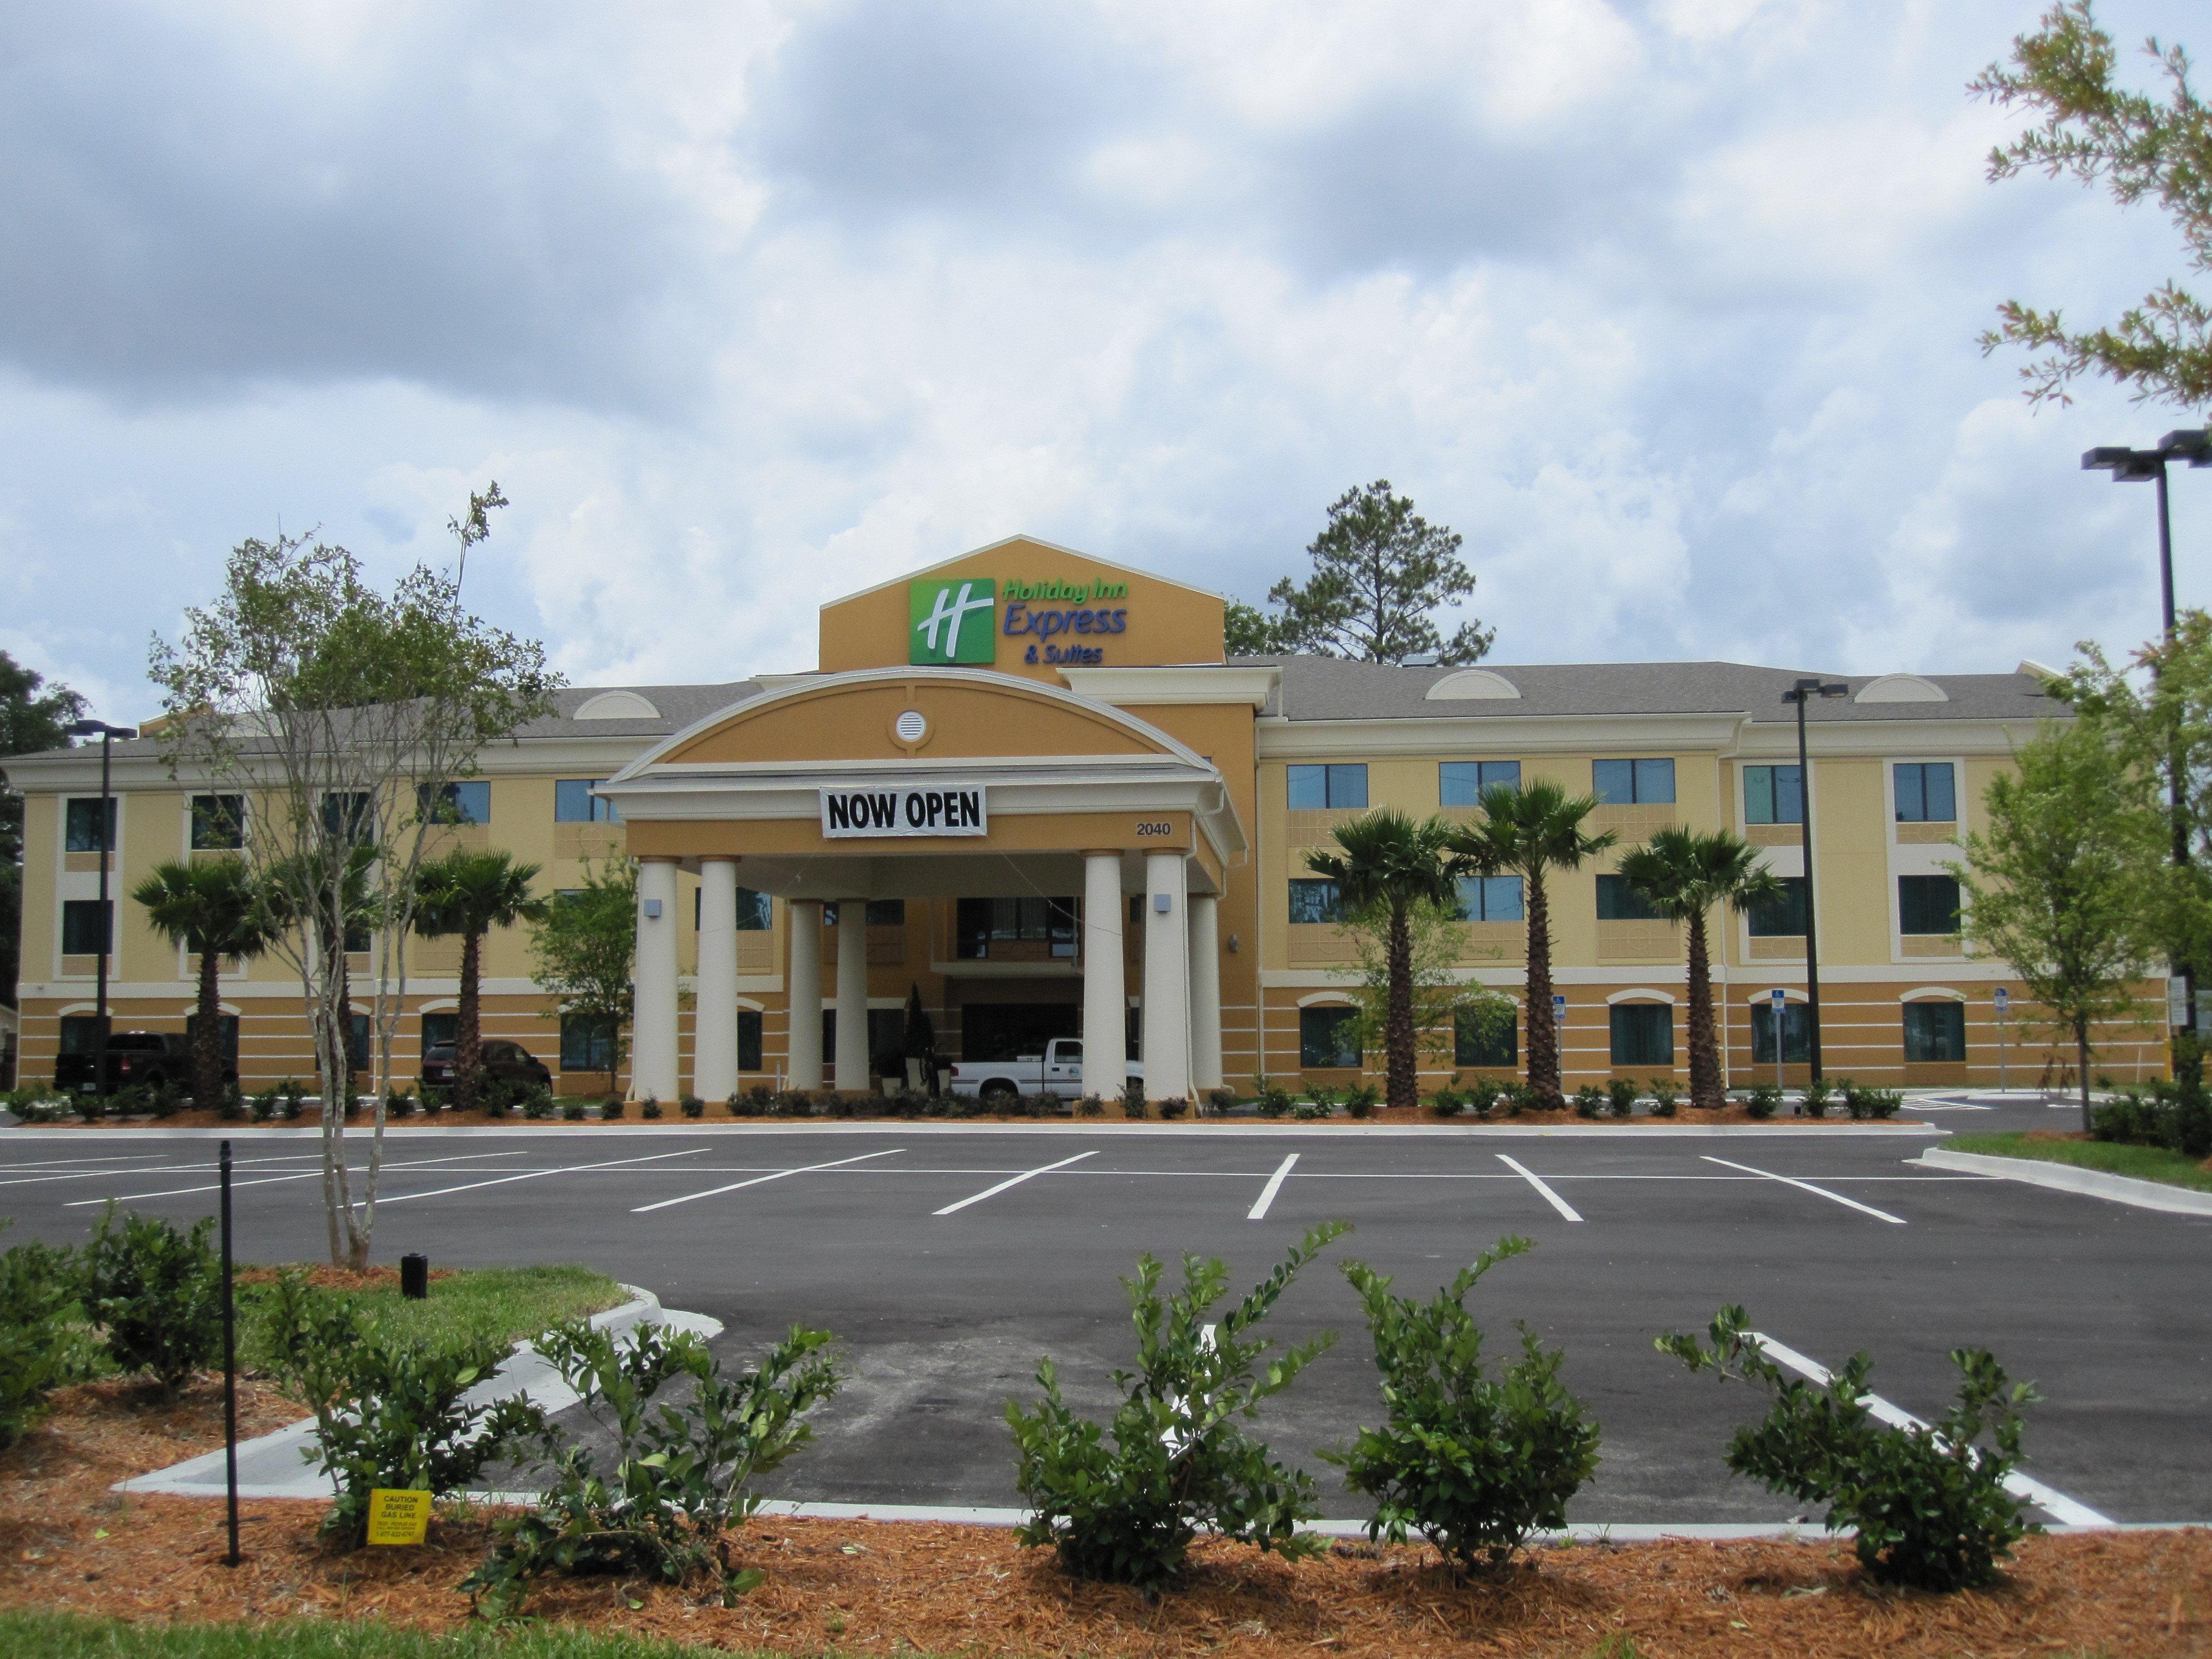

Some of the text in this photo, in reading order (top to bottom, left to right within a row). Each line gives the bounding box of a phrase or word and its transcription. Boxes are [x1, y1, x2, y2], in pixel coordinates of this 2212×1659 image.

[1003, 577, 1127, 604] Holiday Inn
[1003, 603, 1127, 642] Express
[1024, 644, 1103, 664] & Suites
[827, 791, 980, 830] NOW OPEN
[1136, 822, 1171, 836] 2040
